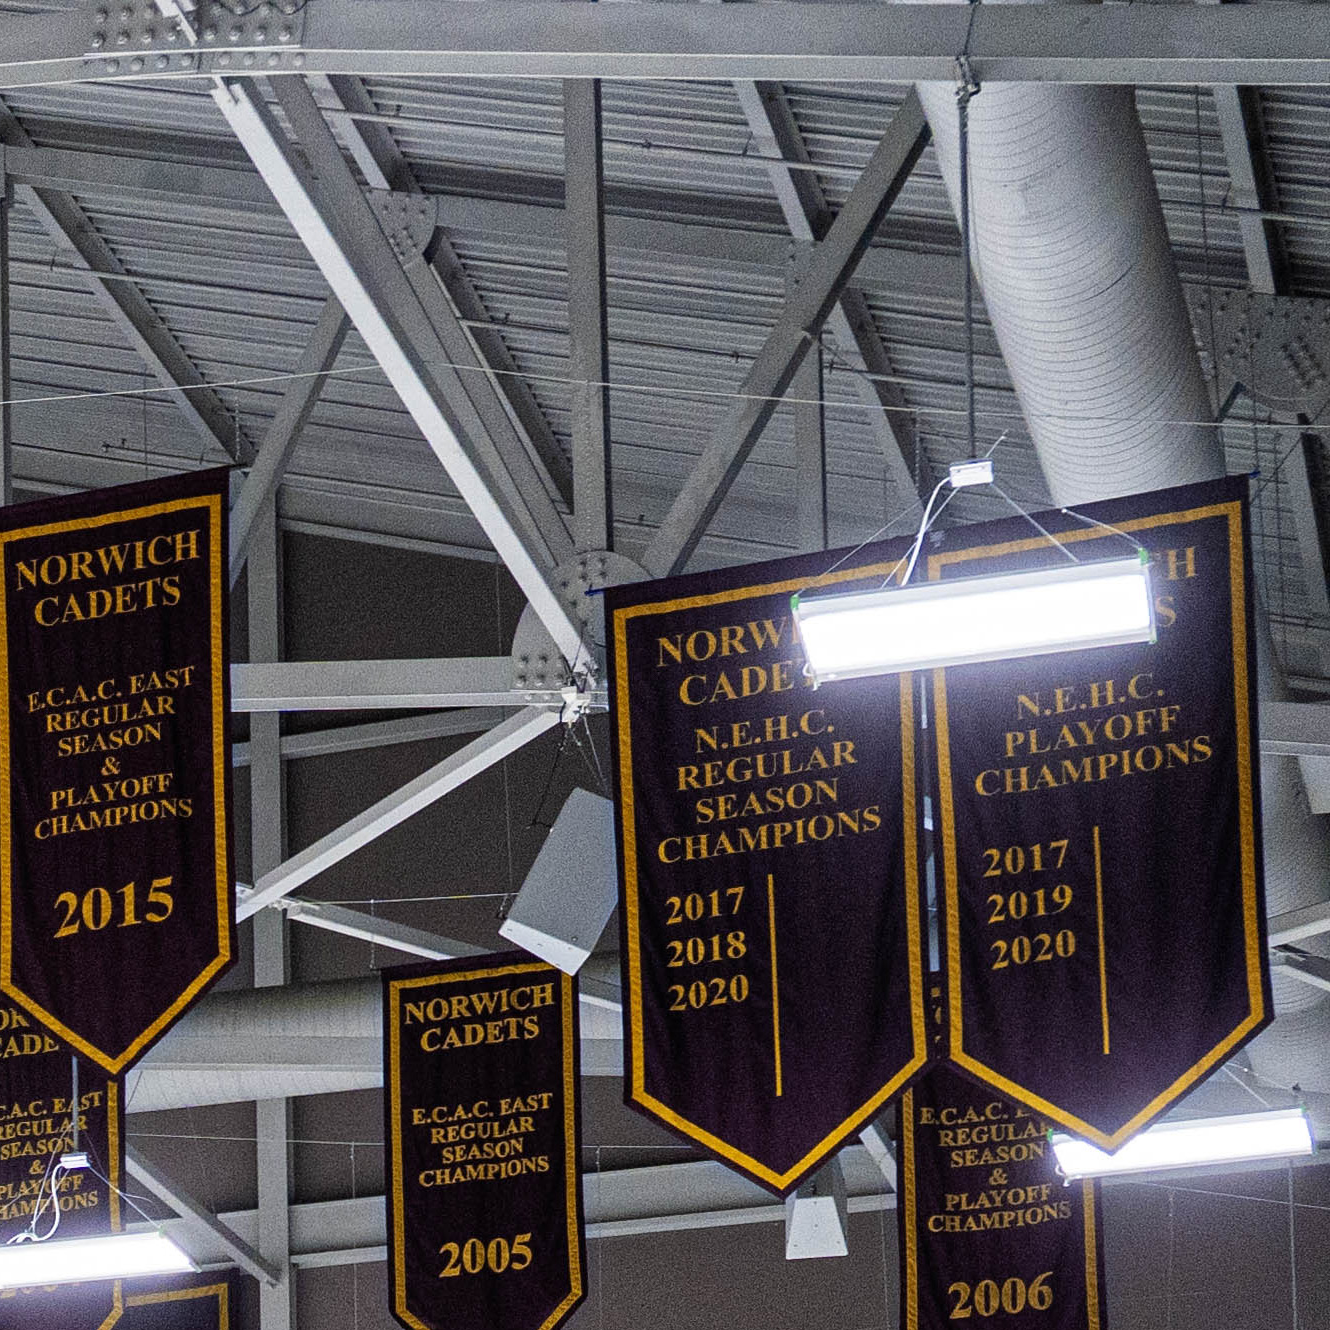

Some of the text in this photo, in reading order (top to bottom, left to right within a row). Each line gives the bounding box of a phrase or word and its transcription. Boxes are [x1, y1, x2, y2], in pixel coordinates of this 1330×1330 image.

[16, 530, 200, 591] NORWICH
[34, 575, 181, 627] CADETS
[28, 665, 195, 714] E.C.A.C. EAST
[1017, 672, 1164, 720] N.E.H.C.
[46, 695, 175, 733] REGULAR
[695, 710, 835, 754] N.E.H.C.
[1005, 704, 1181, 759] PLAYOFF
[57, 723, 161, 757] SEASON
[101, 755, 120, 775] &
[677, 740, 857, 791] REGULAR
[975, 735, 1212, 797] CHAMPIONS
[50, 773, 173, 812] PLAYOFF
[696, 778, 838, 824] SEASON
[34, 798, 192, 840] CHAMPIONS
[657, 806, 881, 865] CHAMPIONS
[982, 839, 1070, 877] 2017
[53, 876, 173, 939] 2015
[665, 886, 745, 925] 2017
[987, 884, 1073, 924] 2019
[666, 931, 746, 969] 2018
[990, 928, 1076, 970] 2020
[404, 982, 554, 1025] NORWICH
[667, 974, 749, 1011] 2020
[420, 1016, 539, 1052] CADETS
[412, 1093, 553, 1126] E.C.A.C. EAST
[430, 1116, 534, 1144] REGULAR
[418, 1156, 549, 1187] CHAMPIONS
[442, 1138, 523, 1164] SEASON
[439, 1232, 532, 1278] 2005
[948, 1271, 1054, 1320] 2006
